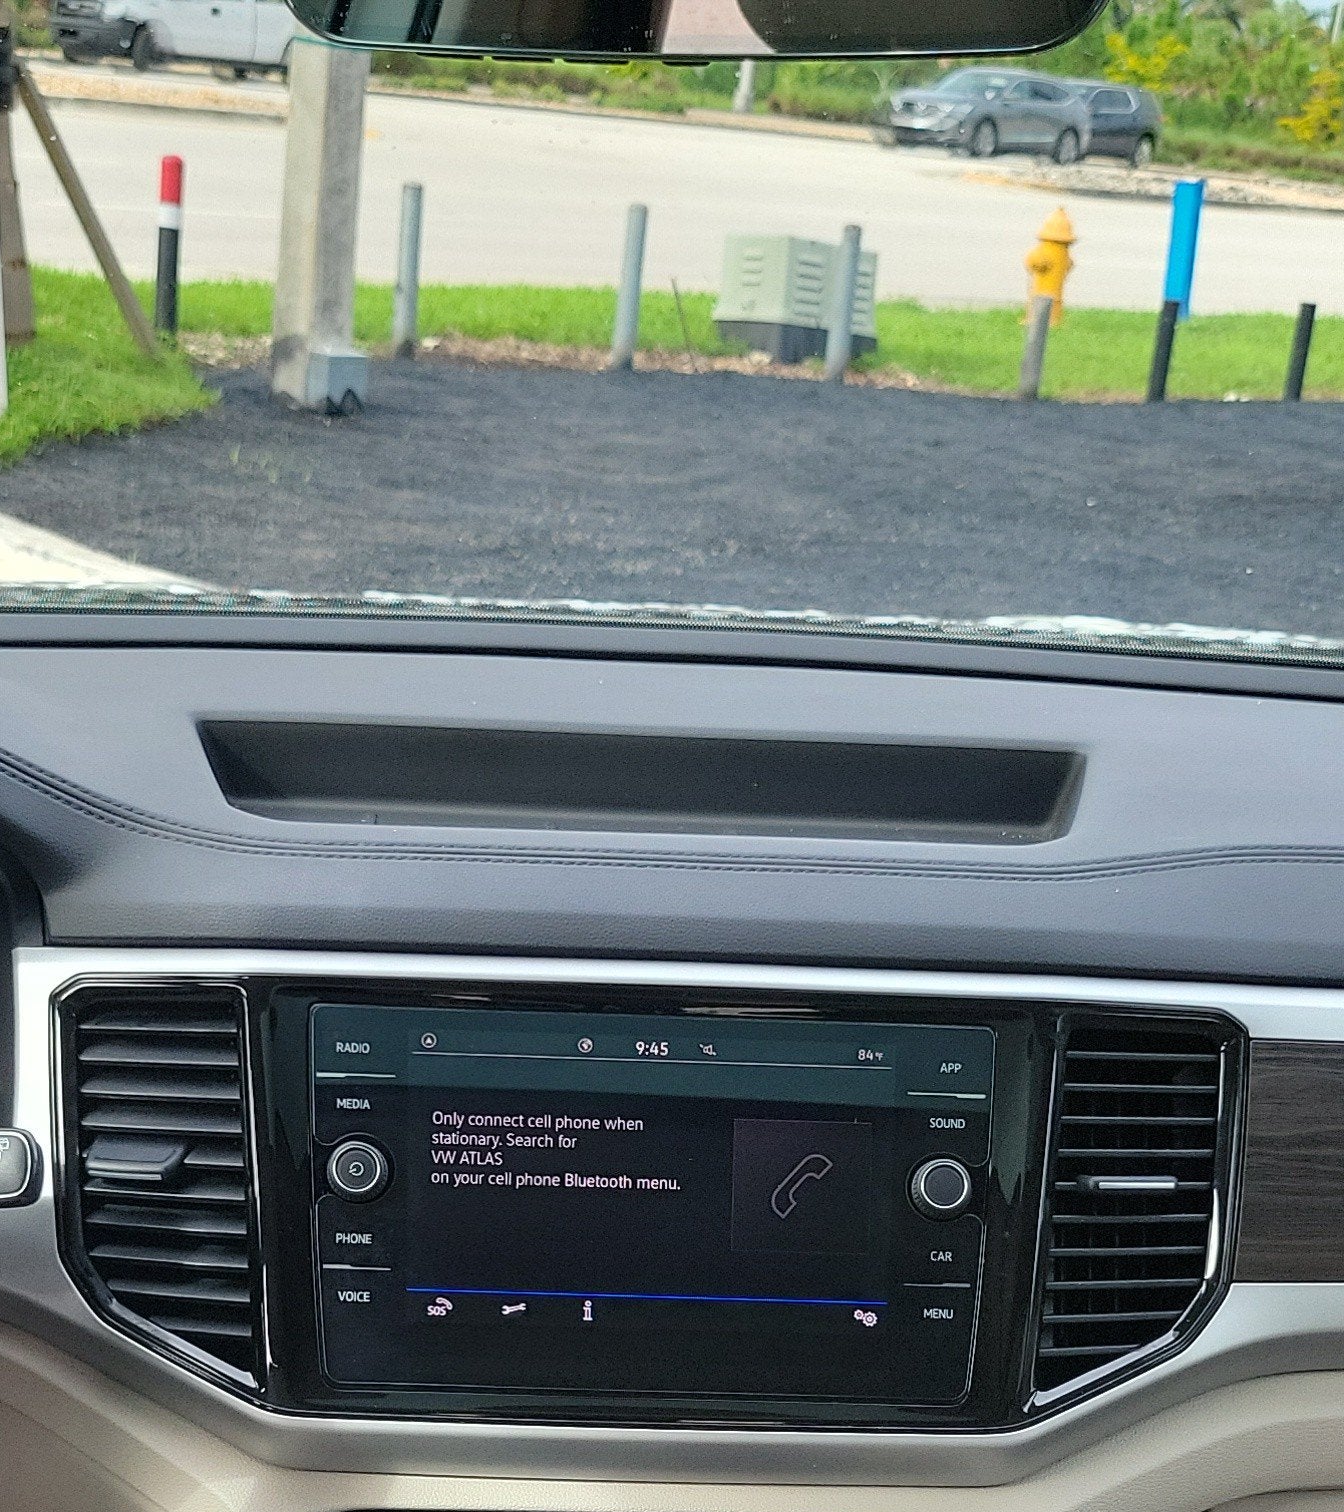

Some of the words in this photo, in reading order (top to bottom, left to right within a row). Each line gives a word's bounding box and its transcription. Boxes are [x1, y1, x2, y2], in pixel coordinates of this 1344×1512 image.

[336, 1042, 370, 1054] RADIO
[635, 1042, 669, 1056] 9:45
[940, 1063, 962, 1074] APP
[336, 1098, 370, 1110] MEDIA
[432, 1111, 464, 1128] Only
[468, 1114, 523, 1128] connect
[528, 1115, 551, 1129] cell
[555, 1115, 601, 1134] phone
[604, 1117, 643, 1131] when
[929, 1118, 966, 1129] SOUND
[431, 1131, 503, 1150] stationary.
[506, 1133, 553, 1148] Search
[558, 1134, 577, 1149] for
[431, 1151, 456, 1164] VW
[459, 1151, 503, 1165] ATLAS
[431, 1172, 449, 1184] on
[453, 1172, 484, 1187] your
[488, 1171, 511, 1185] cell
[515, 1172, 560, 1188] phone
[564, 1173, 632, 1189] Bluetooth
[637, 1177, 681, 1191] menu.
[335, 1233, 372, 1244] PHONE
[930, 1251, 952, 1262] CAR
[338, 1291, 370, 1302] VOICE
[427, 1305, 447, 1316] SOS
[923, 1308, 953, 1320] MENU
